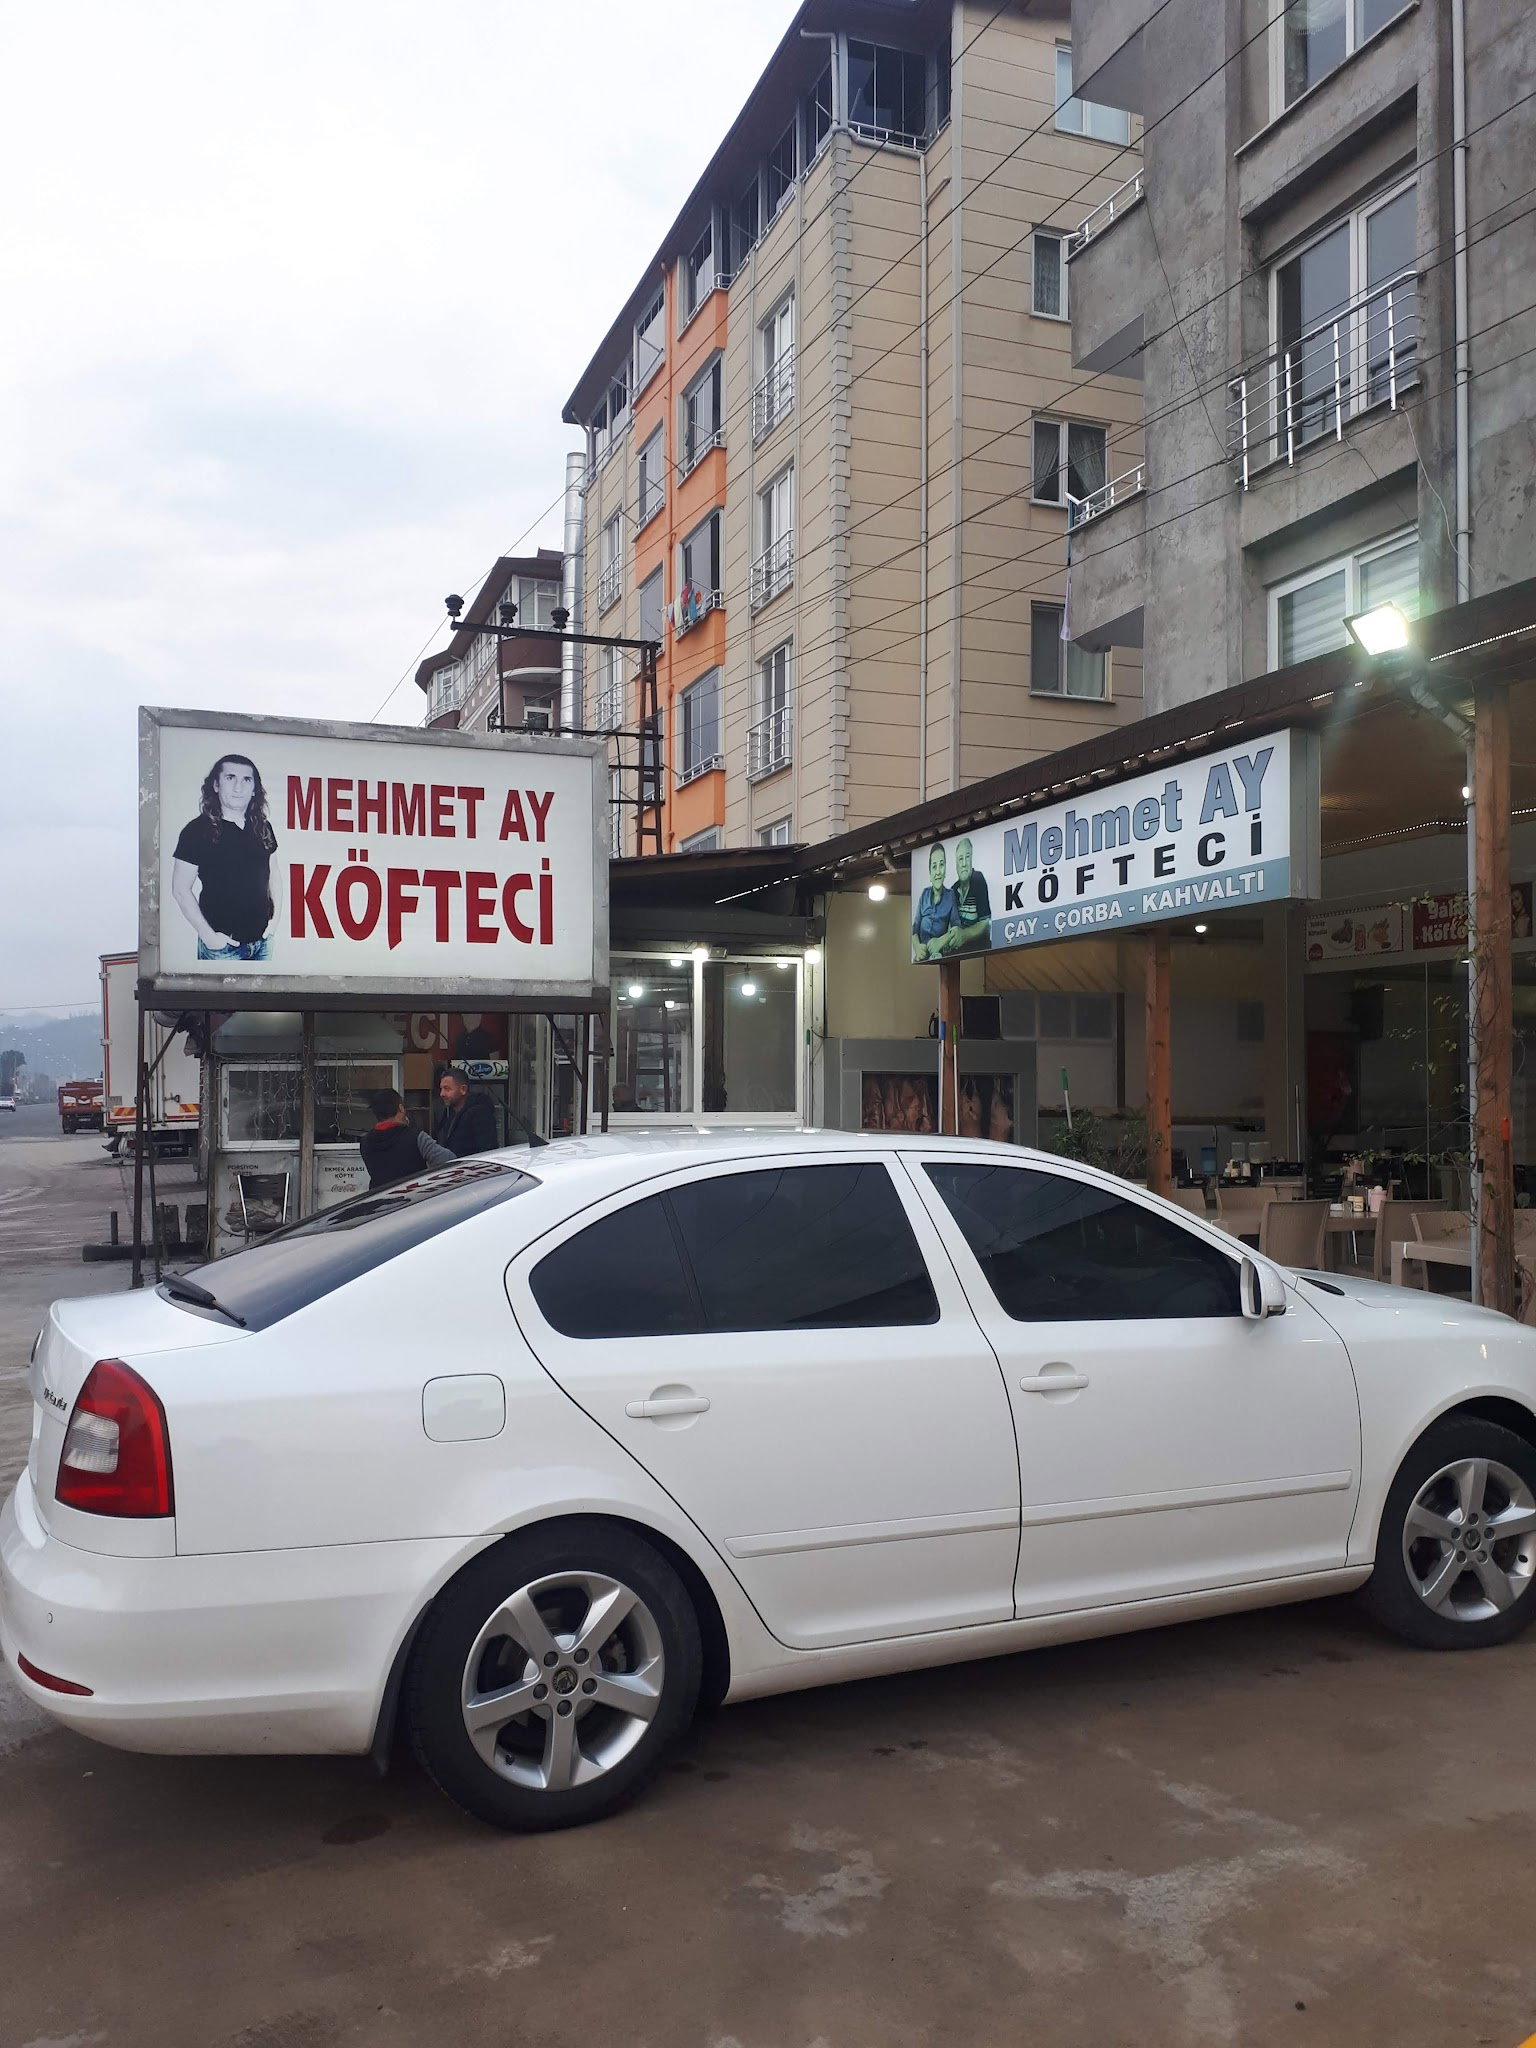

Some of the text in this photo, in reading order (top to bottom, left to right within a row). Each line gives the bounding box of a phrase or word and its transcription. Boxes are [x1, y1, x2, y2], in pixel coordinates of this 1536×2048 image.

[286, 775, 555, 843] MEHMET AY
[1003, 746, 1275, 877] Mehmet AY
[289, 847, 554, 951] KÖFTECİ
[1003, 916, 1039, 945] ÇAY
[1053, 899, 1124, 934] ÇORBA
[1141, 868, 1265, 915] KAHVALTI
[1004, 812, 1263, 912] KÖFTECİ
